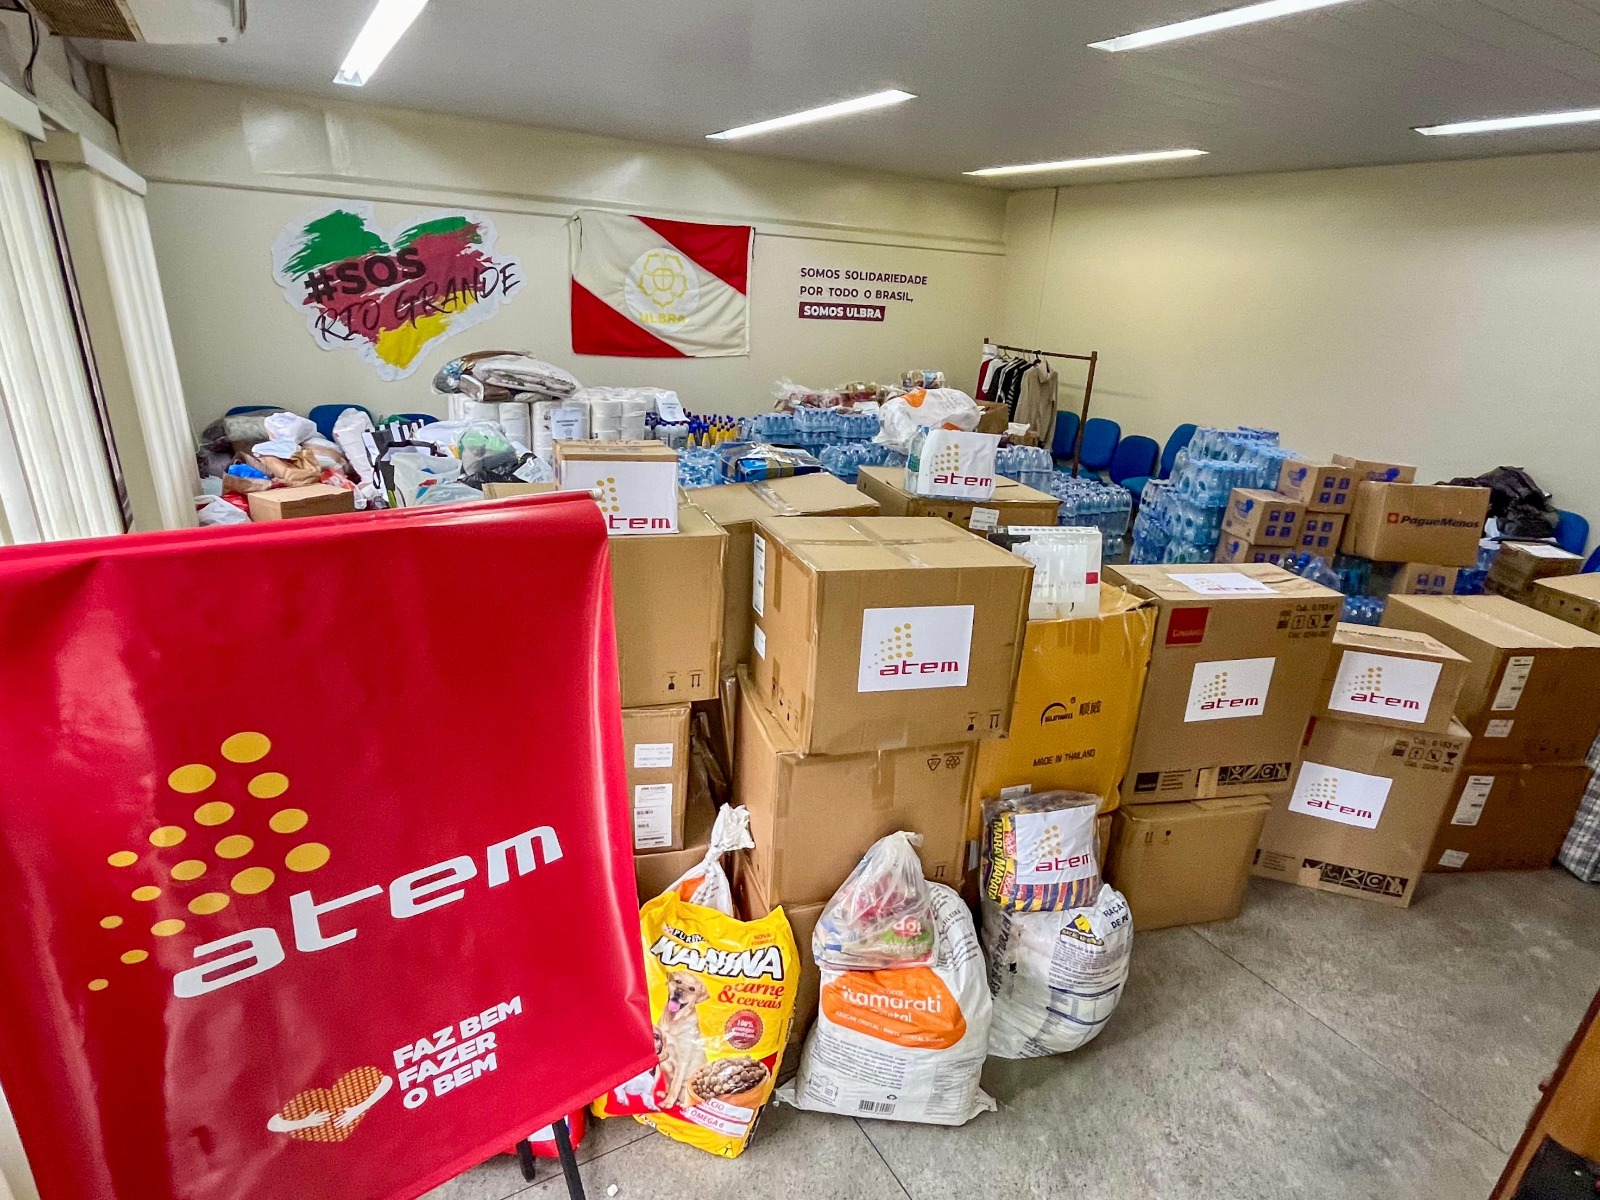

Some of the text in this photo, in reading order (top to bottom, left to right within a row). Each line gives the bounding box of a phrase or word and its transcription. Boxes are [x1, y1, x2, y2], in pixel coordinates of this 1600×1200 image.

[304, 247, 426, 304] #SOS
[800, 267, 928, 285] SOMOS SOLIDARIEDADE
[315, 262, 521, 342] RIO GRANDE
[800, 286, 913, 302] POR TODO O BRASIL,
[803, 305, 881, 319] SOMOS ULBRA
[933, 473, 992, 487] atem
[608, 514, 671, 529] tem
[879, 660, 959, 676] atem
[1200, 697, 1259, 710] atem
[1350, 692, 1420, 710] atem
[1033, 748, 1096, 767] MADE IN THAILAND
[1306, 798, 1372, 819] atem
[173, 825, 564, 998] atem
[650, 935, 785, 981] KANINA
[717, 985, 782, 1009] & cereais
[735, 982, 785, 999] carne
[842, 985, 942, 1013] itamarati
[393, 995, 522, 1070] FAZ BEM
[398, 1031, 498, 1091] FAZER
[403, 1052, 498, 1109] O BEM
